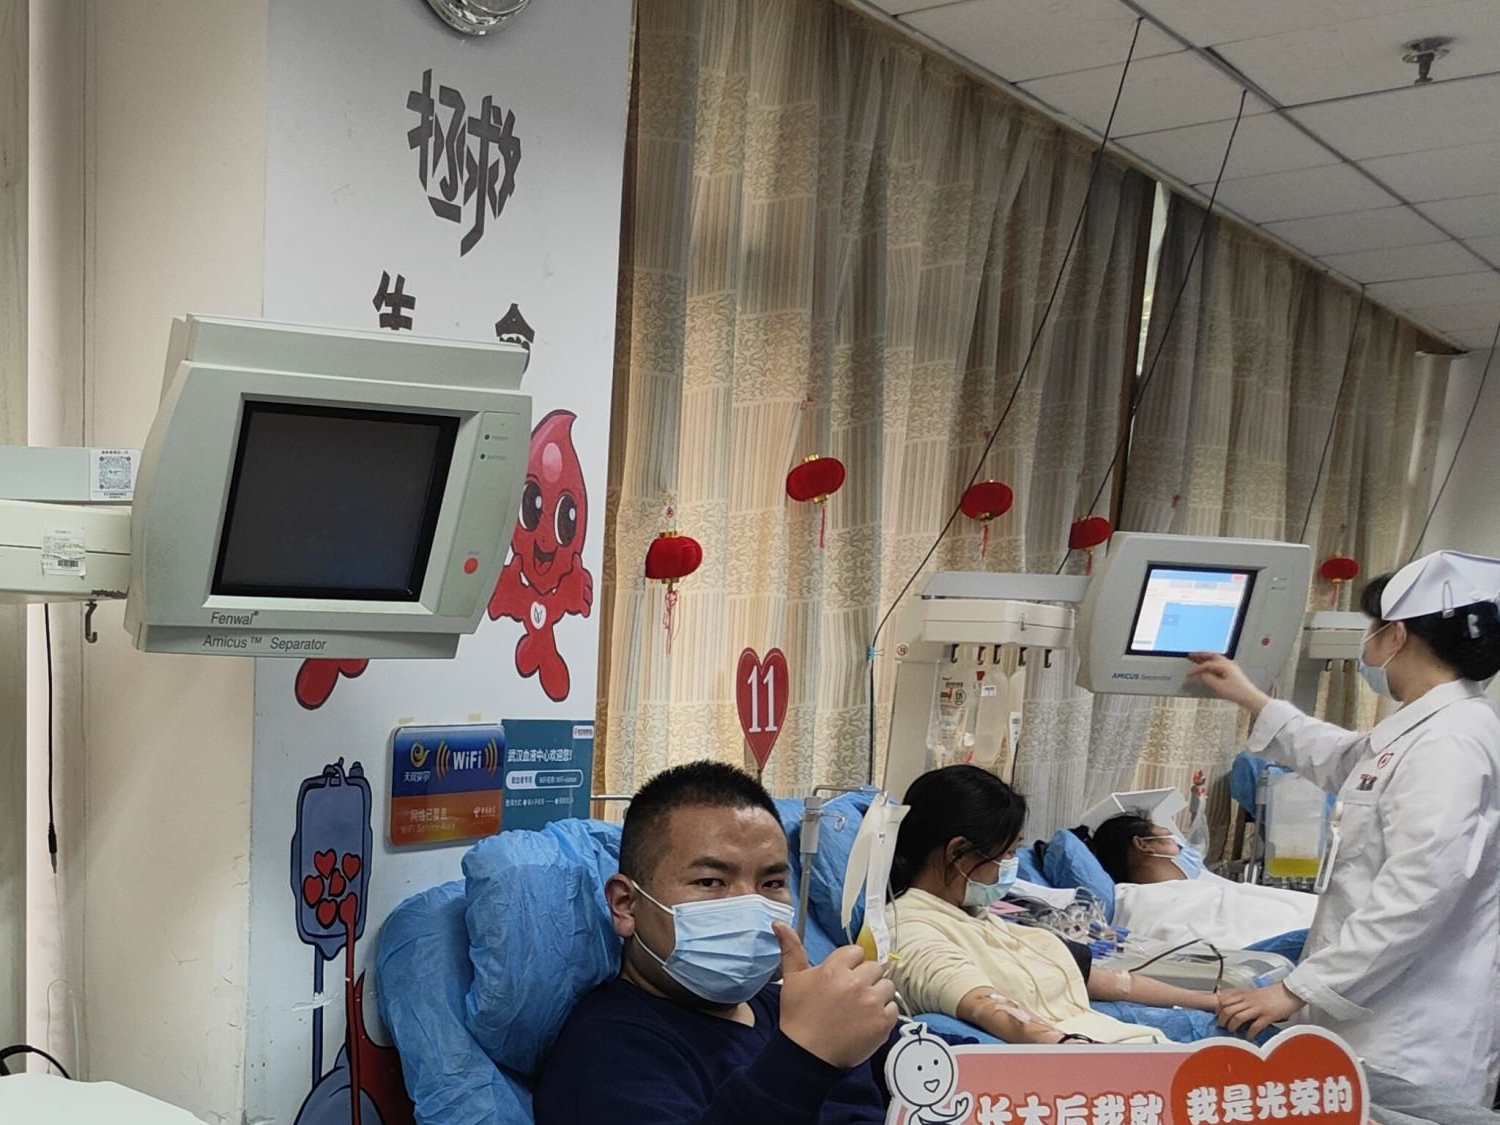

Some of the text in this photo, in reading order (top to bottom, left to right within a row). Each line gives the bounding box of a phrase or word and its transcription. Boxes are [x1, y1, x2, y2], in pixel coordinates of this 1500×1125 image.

[270, 637, 327, 652] Separator
[747, 664, 779, 734] 11
[453, 750, 482, 770] WiFi
[1186, 1075, 1353, 1125] 我是光荣的
